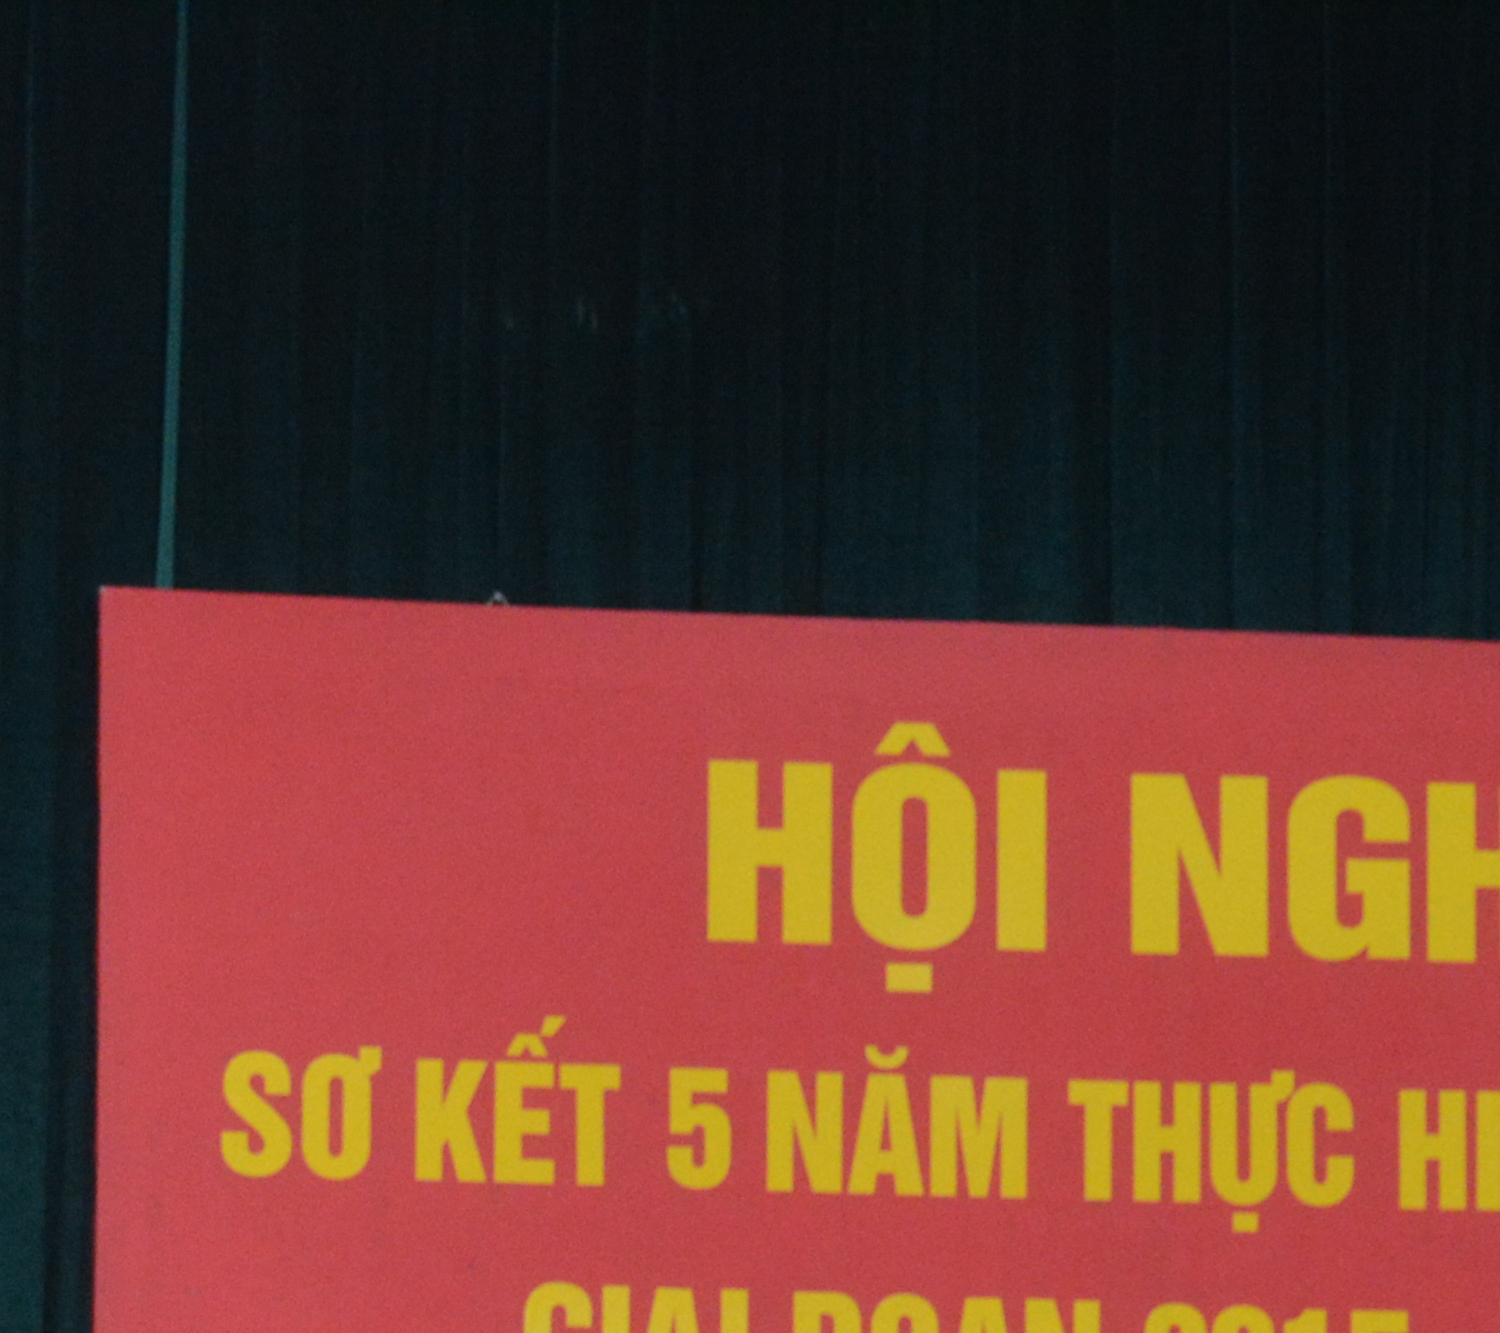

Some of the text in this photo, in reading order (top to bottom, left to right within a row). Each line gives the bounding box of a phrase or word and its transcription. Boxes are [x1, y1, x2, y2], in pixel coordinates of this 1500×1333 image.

[707, 720, 1047, 994] HỘI
[220, 1046, 382, 1180] SƠ
[416, 1016, 622, 1187] KẾT
[667, 1067, 733, 1190] 5
[767, 1045, 1028, 1200] NĂM
[1069, 1070, 1355, 1234] THỰC
